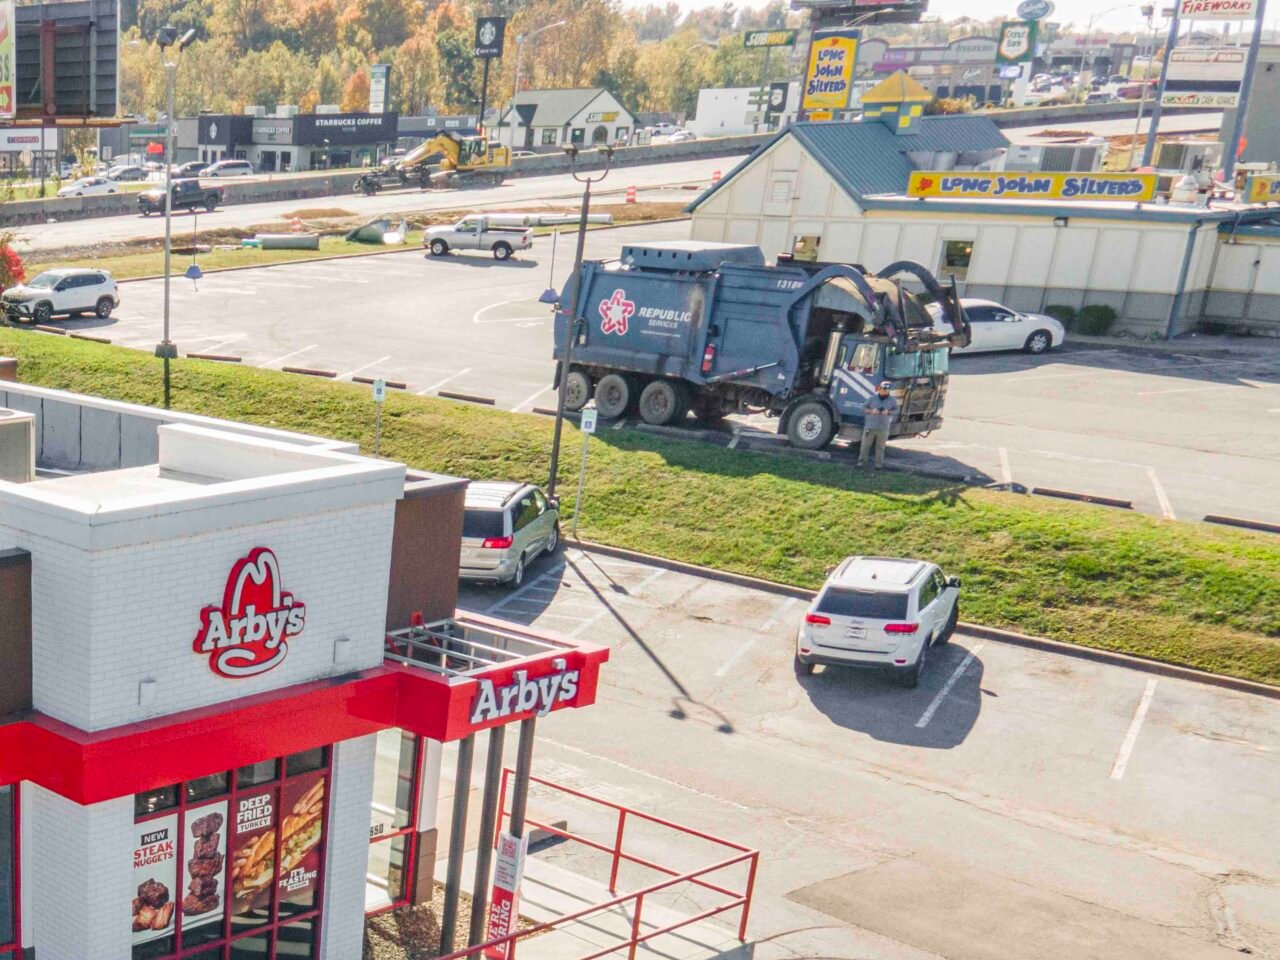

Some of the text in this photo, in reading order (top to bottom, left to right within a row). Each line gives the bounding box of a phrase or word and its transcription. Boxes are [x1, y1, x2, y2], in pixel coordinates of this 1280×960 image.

[1182, 0, 1252, 14] FIREWORKS
[745, 31, 792, 46] SUBWAY
[1007, 30, 1025, 38] Donut
[1006, 40, 1021, 48] Bank
[315, 118, 382, 127] STARBUCKS COFFEE
[586, 111, 619, 123] SUBWAY
[638, 307, 692, 322] REPUBLIC
[648, 319, 678, 329] SERVICES
[200, 595, 306, 652] Arby's
[470, 658, 579, 725] Arby's
[240, 794, 271, 812] DEEP
[236, 805, 273, 824] FRIED
[239, 818, 270, 832] TURKEY
[143, 831, 167, 844] NEW
[133, 840, 174, 860] STEAK
[133, 851, 174, 869] NUGGETS
[278, 870, 317, 888] FEASTING
